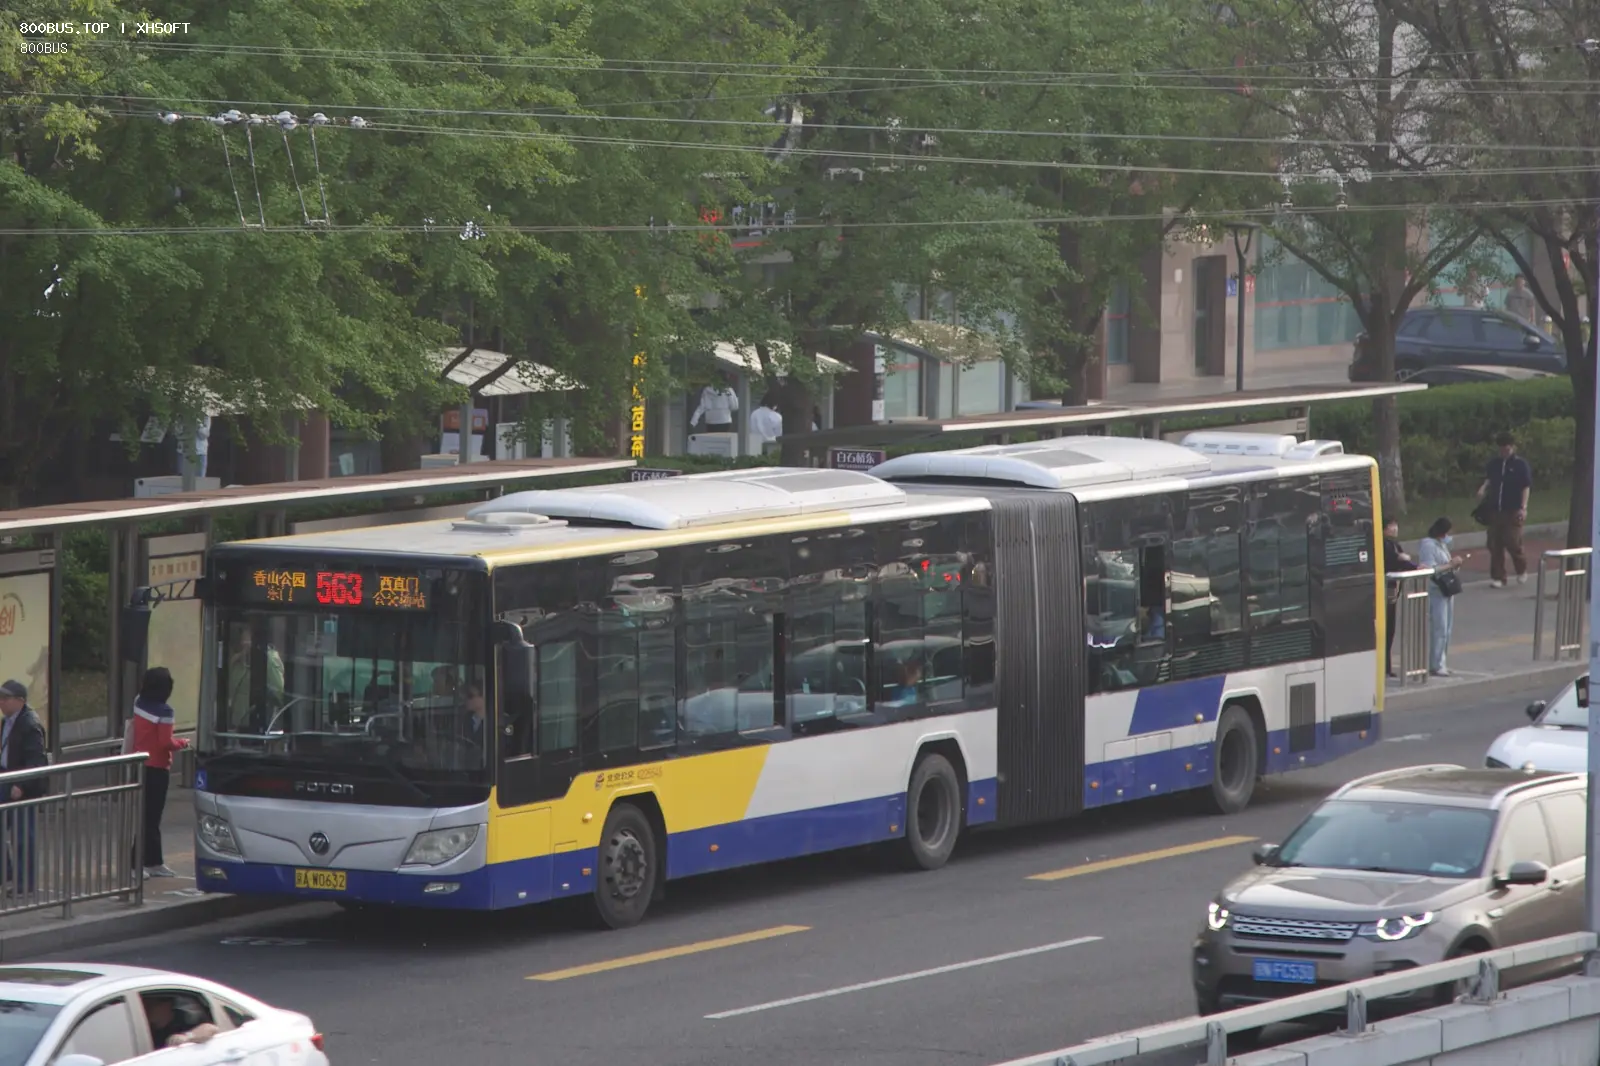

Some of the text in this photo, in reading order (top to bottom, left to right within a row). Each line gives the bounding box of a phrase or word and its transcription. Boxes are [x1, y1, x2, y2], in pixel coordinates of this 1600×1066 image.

[253, 570, 306, 588] 香山公园
[379, 576, 419, 592] 西直门
[316, 571, 362, 605] 563
[295, 782, 354, 794] FOTON
